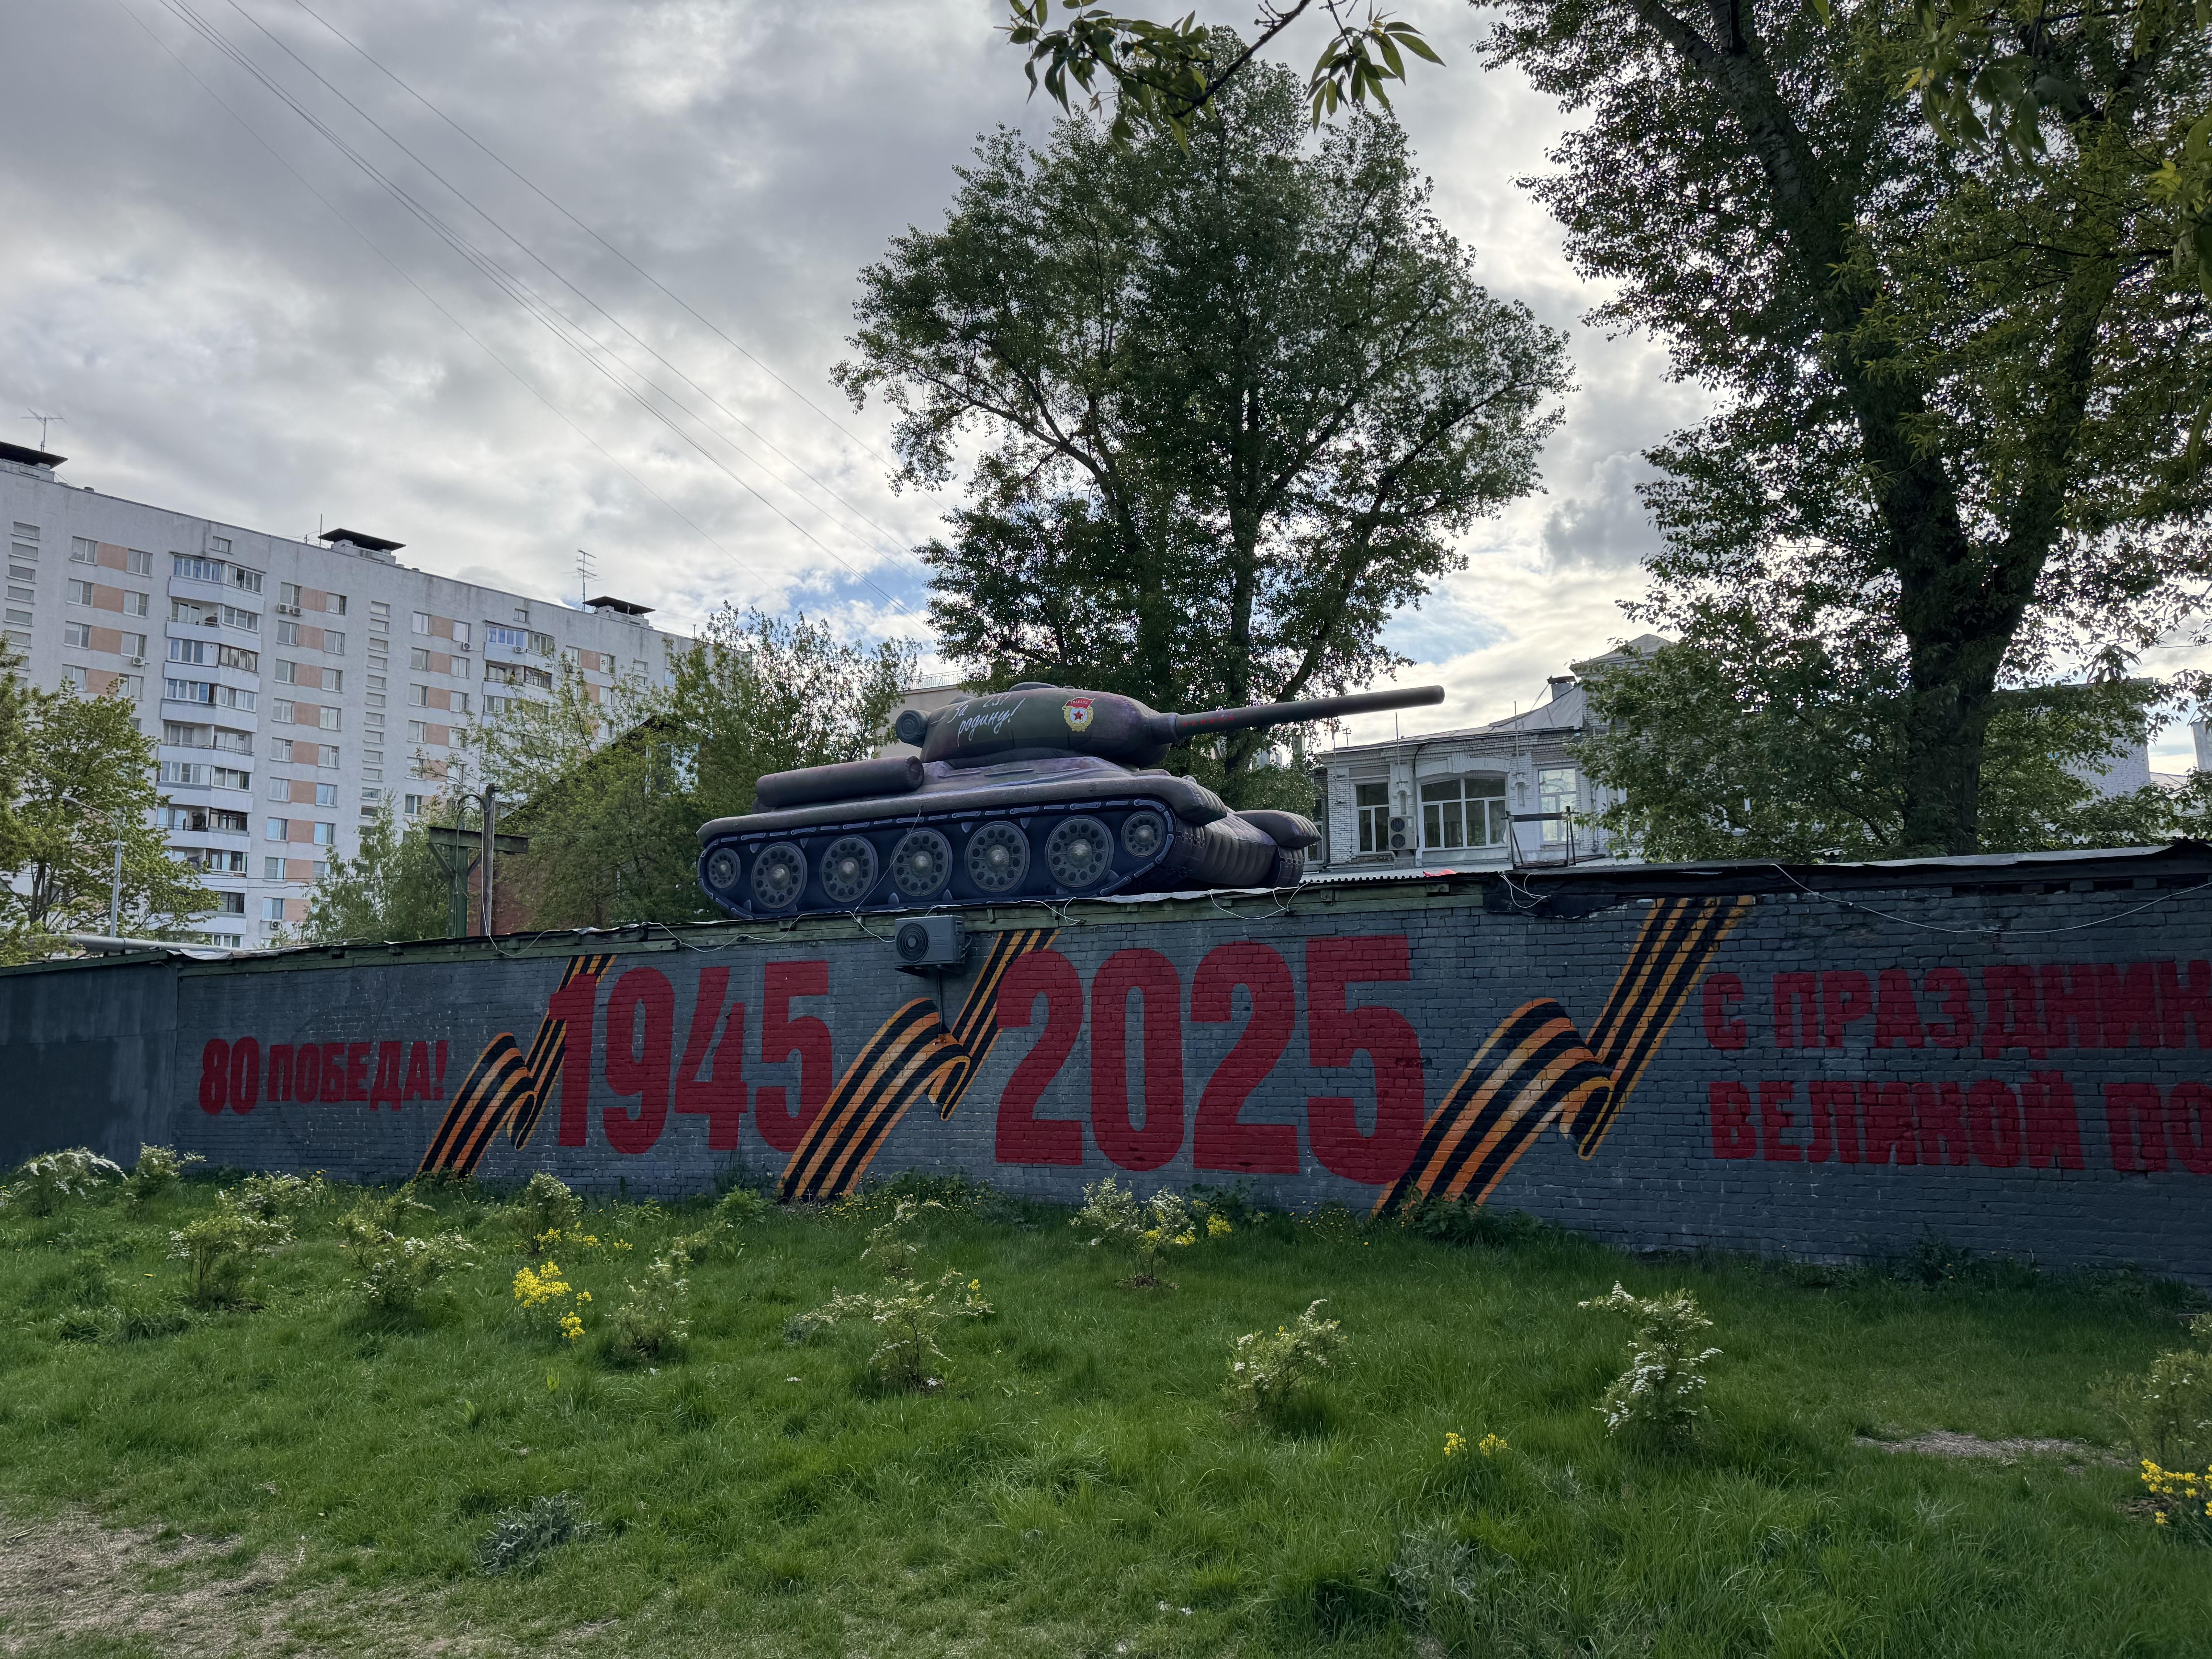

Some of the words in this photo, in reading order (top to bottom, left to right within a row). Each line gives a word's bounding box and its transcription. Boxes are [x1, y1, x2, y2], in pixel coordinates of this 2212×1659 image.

[549, 960, 833, 1154] 1945
[1704, 973, 1746, 1050] С
[1773, 960, 2212, 1059] ПРАЗДНИК
[199, 1036, 260, 1115] 80
[267, 1040, 448, 1112] ПОБЕДА!
[995, 934, 1424, 1185] 2025
[1709, 1071, 2085, 1170] ВЕЛИКОЙ
